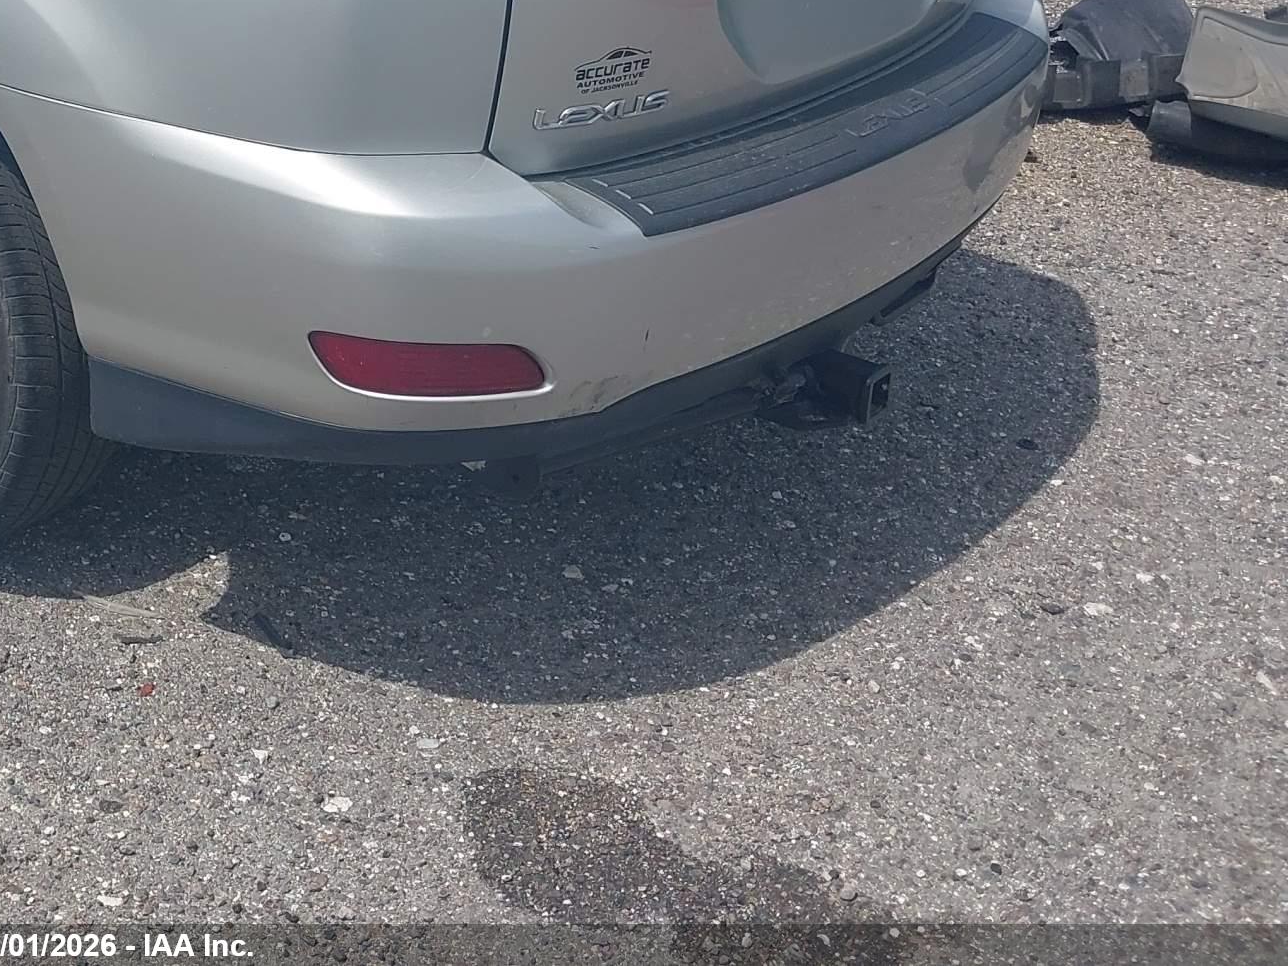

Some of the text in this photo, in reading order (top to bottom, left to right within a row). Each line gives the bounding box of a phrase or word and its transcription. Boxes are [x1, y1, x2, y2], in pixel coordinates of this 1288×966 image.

[577, 71, 645, 89] AUTOMOTIVE
[591, 79, 639, 94] JACKSONVILLE
[532, 89, 670, 131] LEXUS
